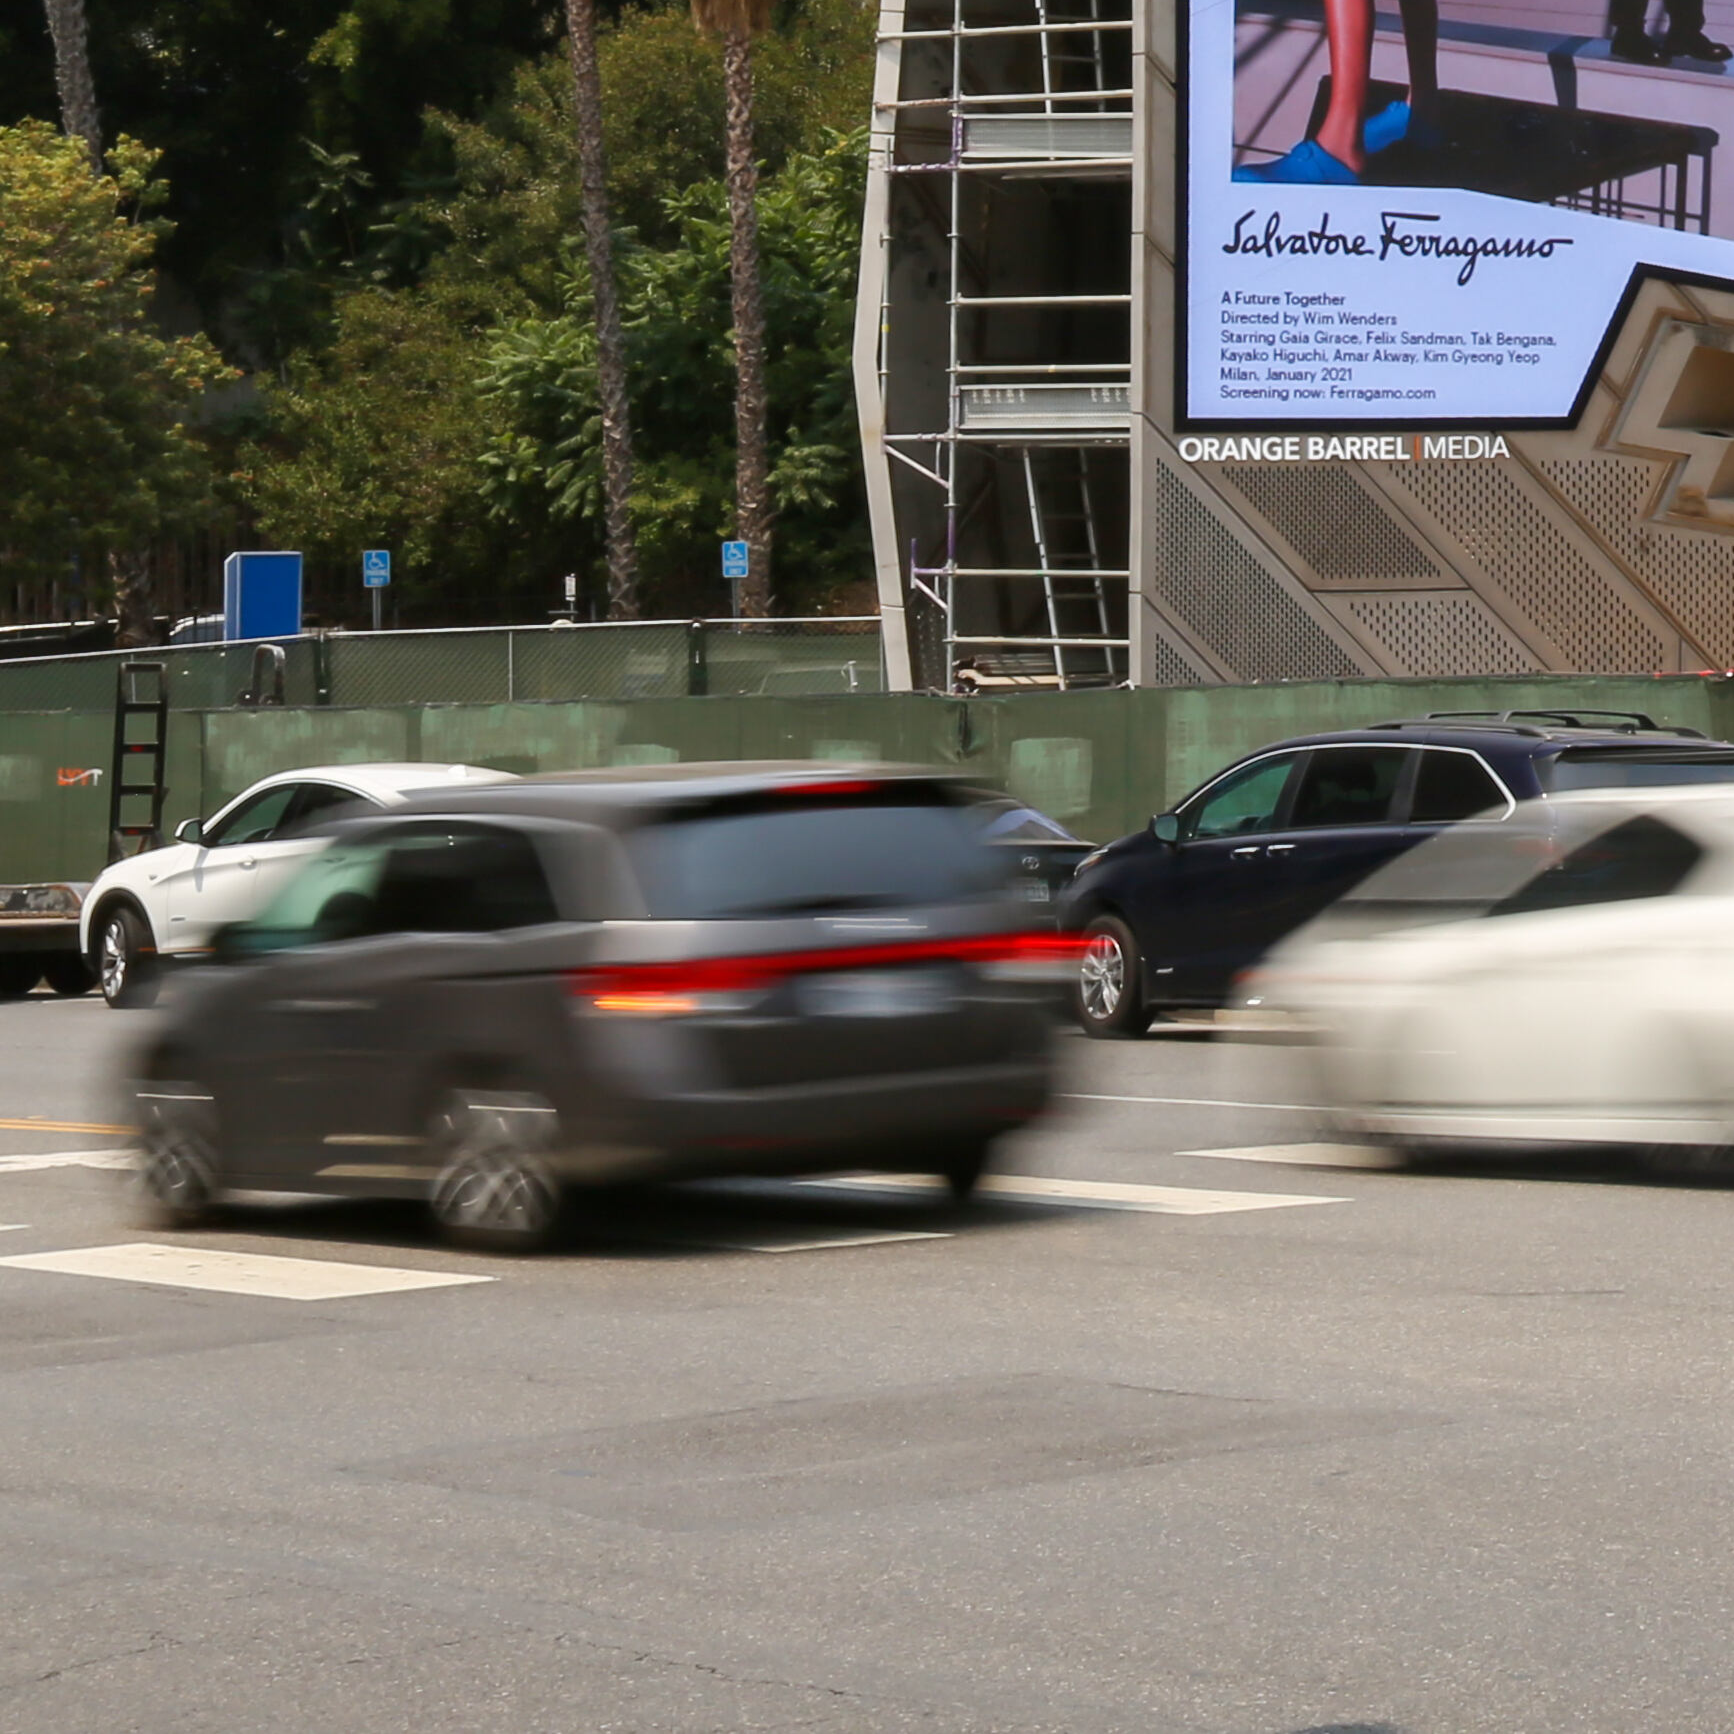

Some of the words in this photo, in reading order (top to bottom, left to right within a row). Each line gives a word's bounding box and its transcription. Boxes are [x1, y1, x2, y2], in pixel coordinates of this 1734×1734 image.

[1222, 210, 1374, 258] Salvatore
[1378, 212, 1574, 286] Ferragamo
[1221, 291, 1232, 305] A
[1234, 290, 1281, 305] Future
[1284, 291, 1345, 308] Together
[1221, 310, 1280, 325] Directed
[1283, 311, 1300, 327] by
[1302, 311, 1335, 325] Wim
[1337, 312, 1397, 326] Wenders
[1221, 329, 1276, 347] Starring
[1279, 330, 1310, 344] Gaia
[1366, 330, 1396, 345] Felix
[1401, 331, 1466, 345] Sandman,
[1471, 331, 1491, 346] Tak
[1220, 348, 1269, 364] Kayako
[1333, 348, 1369, 363] Amar
[1423, 349, 1449, 363] Kim
[1451, 349, 1504, 366] Gyeong
[1507, 350, 1541, 365] Yeop
[1220, 366, 1260, 382] Milan,
[1265, 367, 1317, 383] January
[1320, 367, 1352, 382] 2021
[1220, 384, 1290, 402] Screening
[1330, 384, 1437, 402] Ferragamo.com
[1178, 437, 1300, 462] ORANGE
[1307, 436, 1411, 461] BARREL
[1423, 435, 1511, 460] MEDIA
